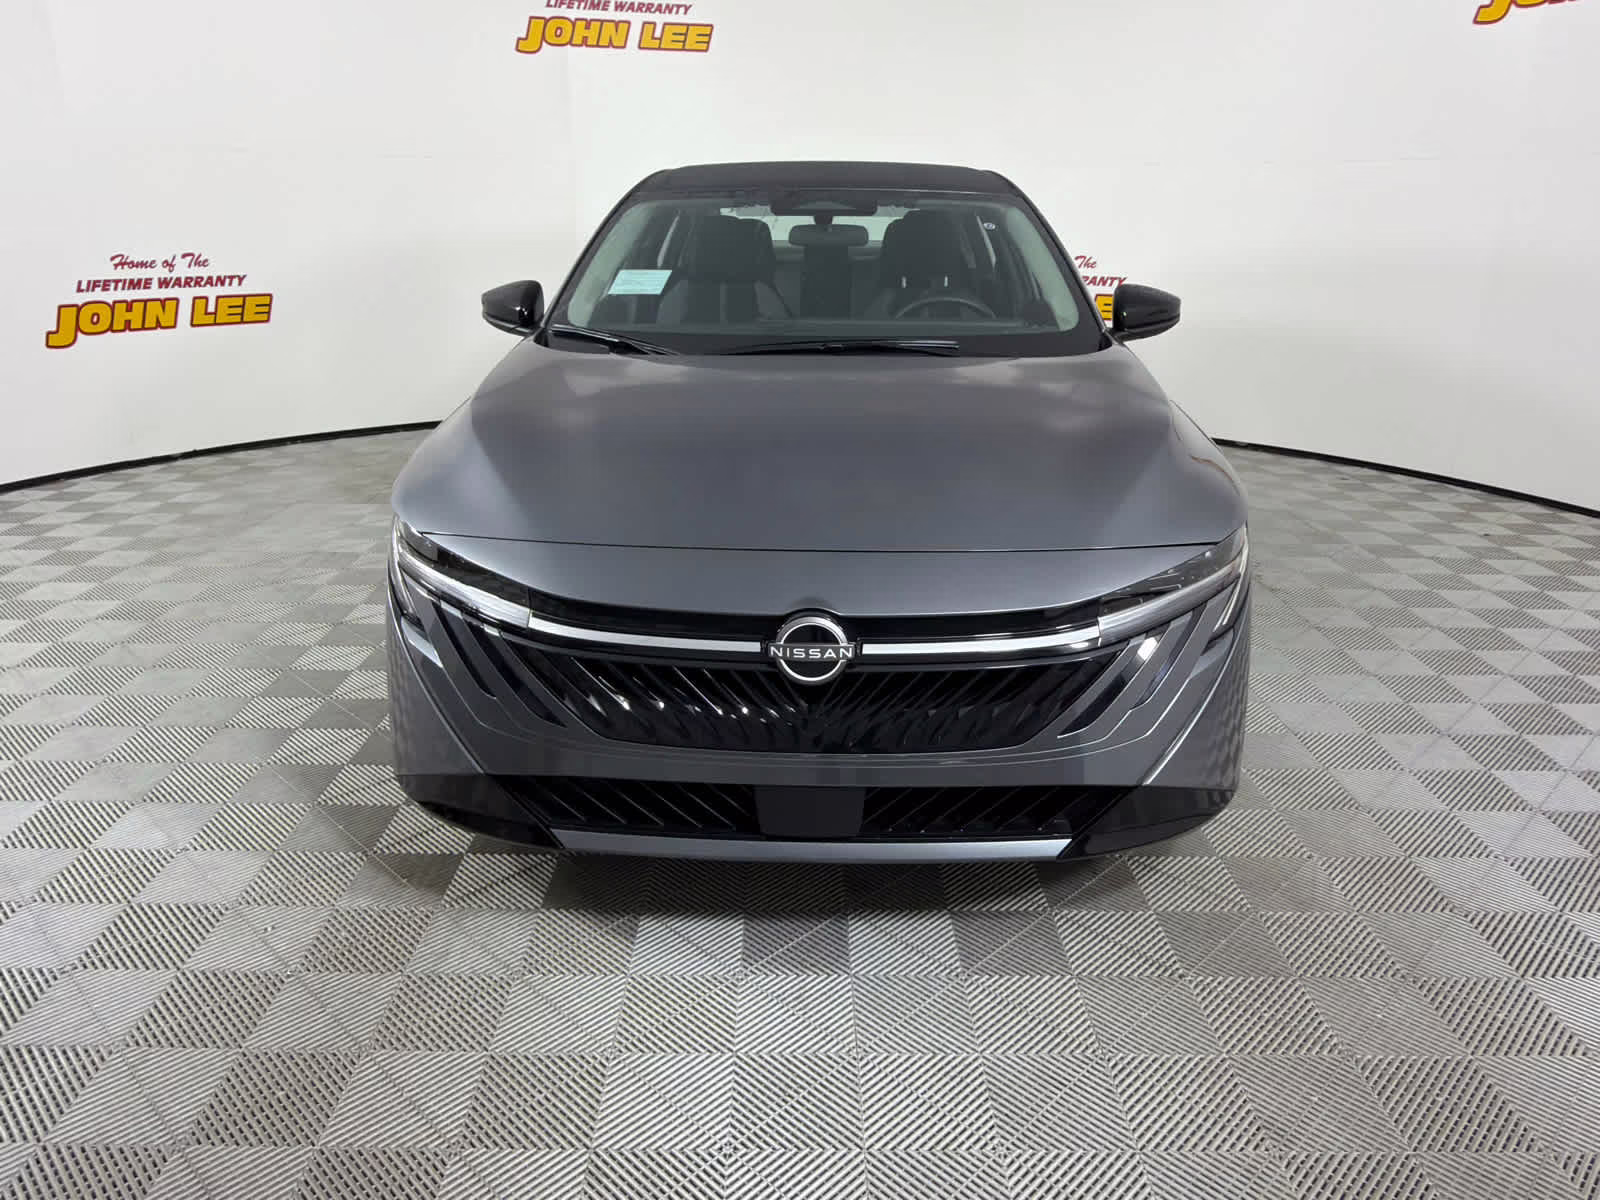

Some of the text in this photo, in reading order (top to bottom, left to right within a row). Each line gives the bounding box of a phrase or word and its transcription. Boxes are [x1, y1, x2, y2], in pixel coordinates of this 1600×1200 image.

[545, 0, 692, 15] LIFETIME WARRANTY
[515, 16, 714, 54] JOHN LEE
[110, 252, 210, 272] Home of The
[1074, 255, 1097, 269] The
[76, 274, 247, 293] LIFETIME WARRANTY
[45, 293, 273, 349] JOHN LEE
[770, 646, 853, 659] NISSAN
